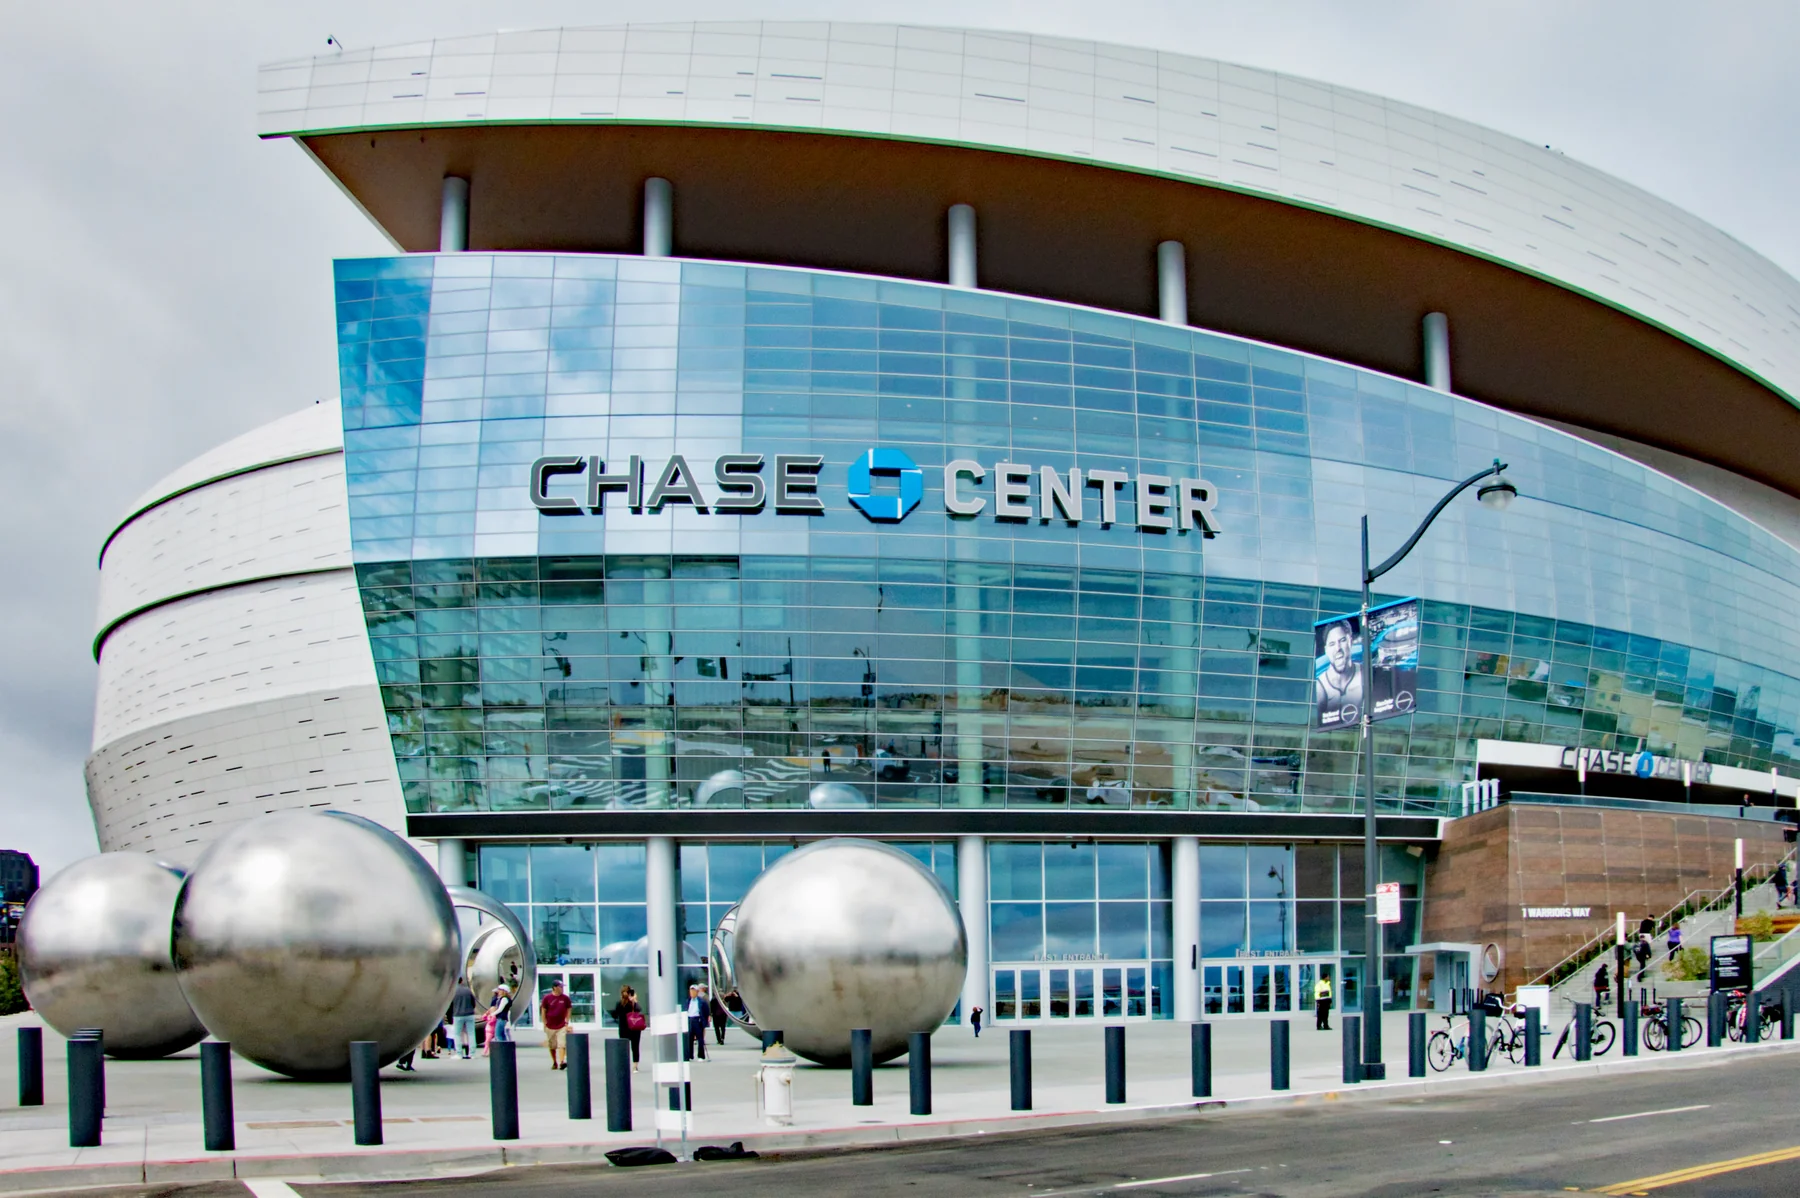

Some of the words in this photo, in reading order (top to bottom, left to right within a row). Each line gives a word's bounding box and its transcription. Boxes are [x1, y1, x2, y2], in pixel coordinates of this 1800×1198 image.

[530, 454, 825, 509] CHASE
[944, 459, 1221, 533] CENTER
[1560, 747, 1633, 775] CHASE
[1522, 908, 1527, 918] 1
[1527, 907, 1571, 918] WARRIORS
[1572, 907, 1591, 917] WAY
[571, 957, 585, 965] VIP
[586, 957, 611, 965] EAST
